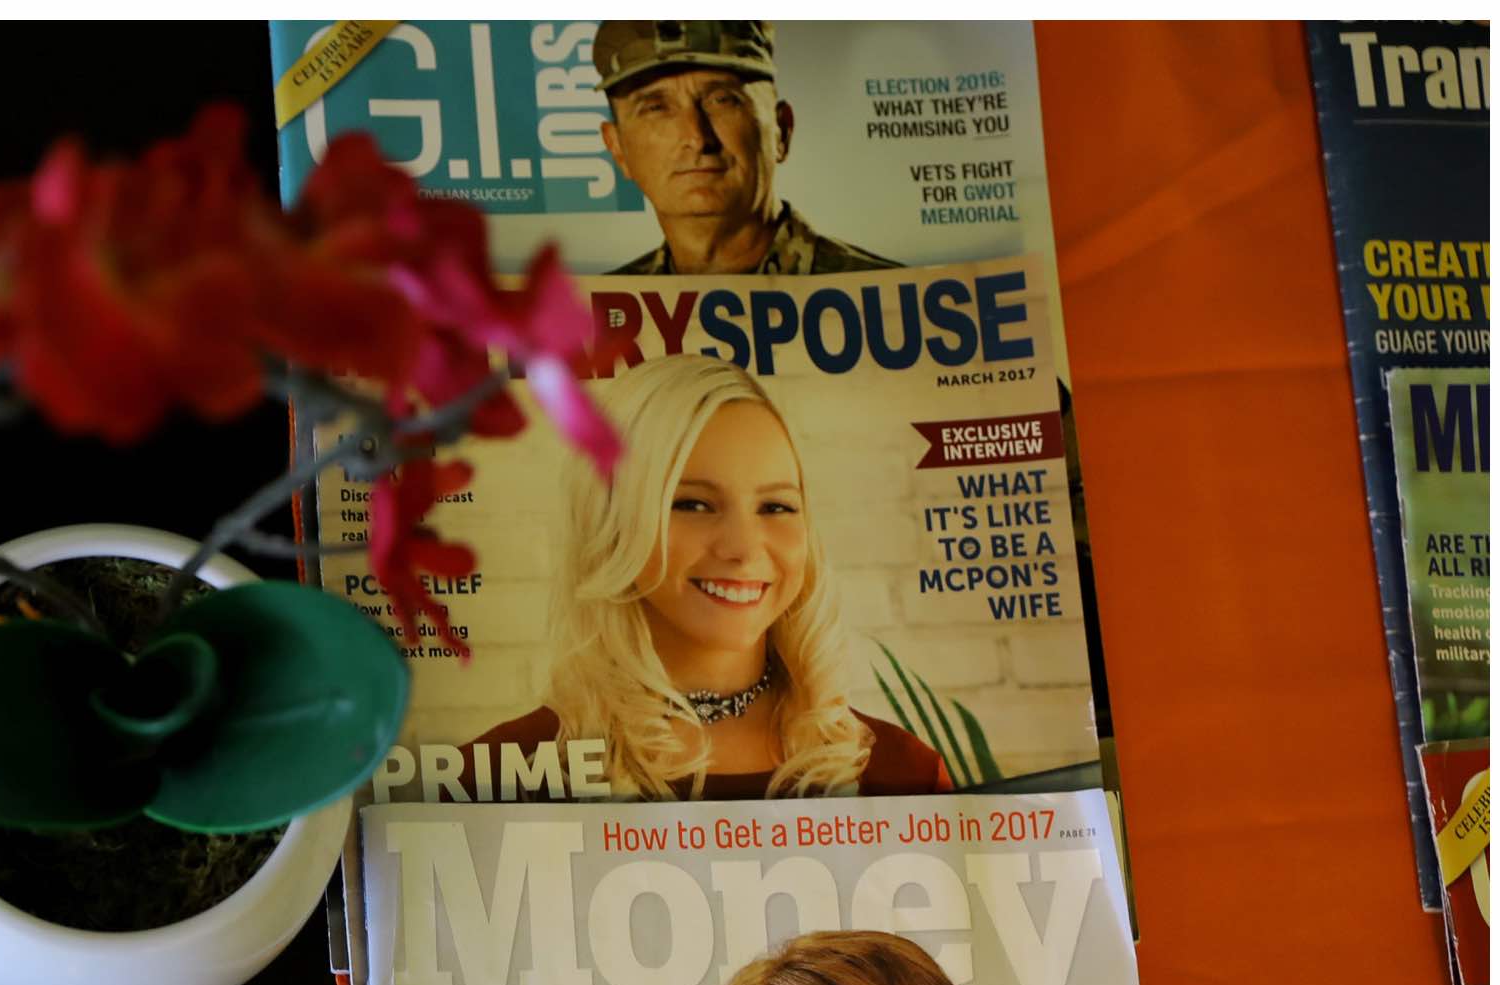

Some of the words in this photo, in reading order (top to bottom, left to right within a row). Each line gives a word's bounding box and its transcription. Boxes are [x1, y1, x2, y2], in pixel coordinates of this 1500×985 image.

[530, 21, 616, 198] JOBS
[1367, 283, 1471, 321] YOUR
[1375, 329, 1437, 355] GUAGE
[937, 372, 994, 387] MARCH
[998, 367, 1036, 382] 2017
[941, 421, 1042, 445] EXCLUSIVE
[943, 438, 1043, 461] INTERVIEW
[957, 469, 1047, 500] WHAT
[925, 505, 978, 532] IT'S
[987, 501, 1051, 529] LIKE
[1426, 534, 1464, 554] ARE
[919, 561, 1059, 593] MCPON'S
[1428, 557, 1464, 577] ALL
[988, 592, 1062, 620] WIFE
[1434, 626, 1481, 641] health
[373, 738, 611, 802] PRIME
[603, 822, 670, 853] How
[677, 823, 706, 851] to
[714, 820, 764, 849] Get
[772, 826, 789, 848] a
[797, 814, 890, 847] Better
[899, 813, 952, 845] Job
[958, 814, 982, 844] in
[990, 810, 1056, 843] 2017
